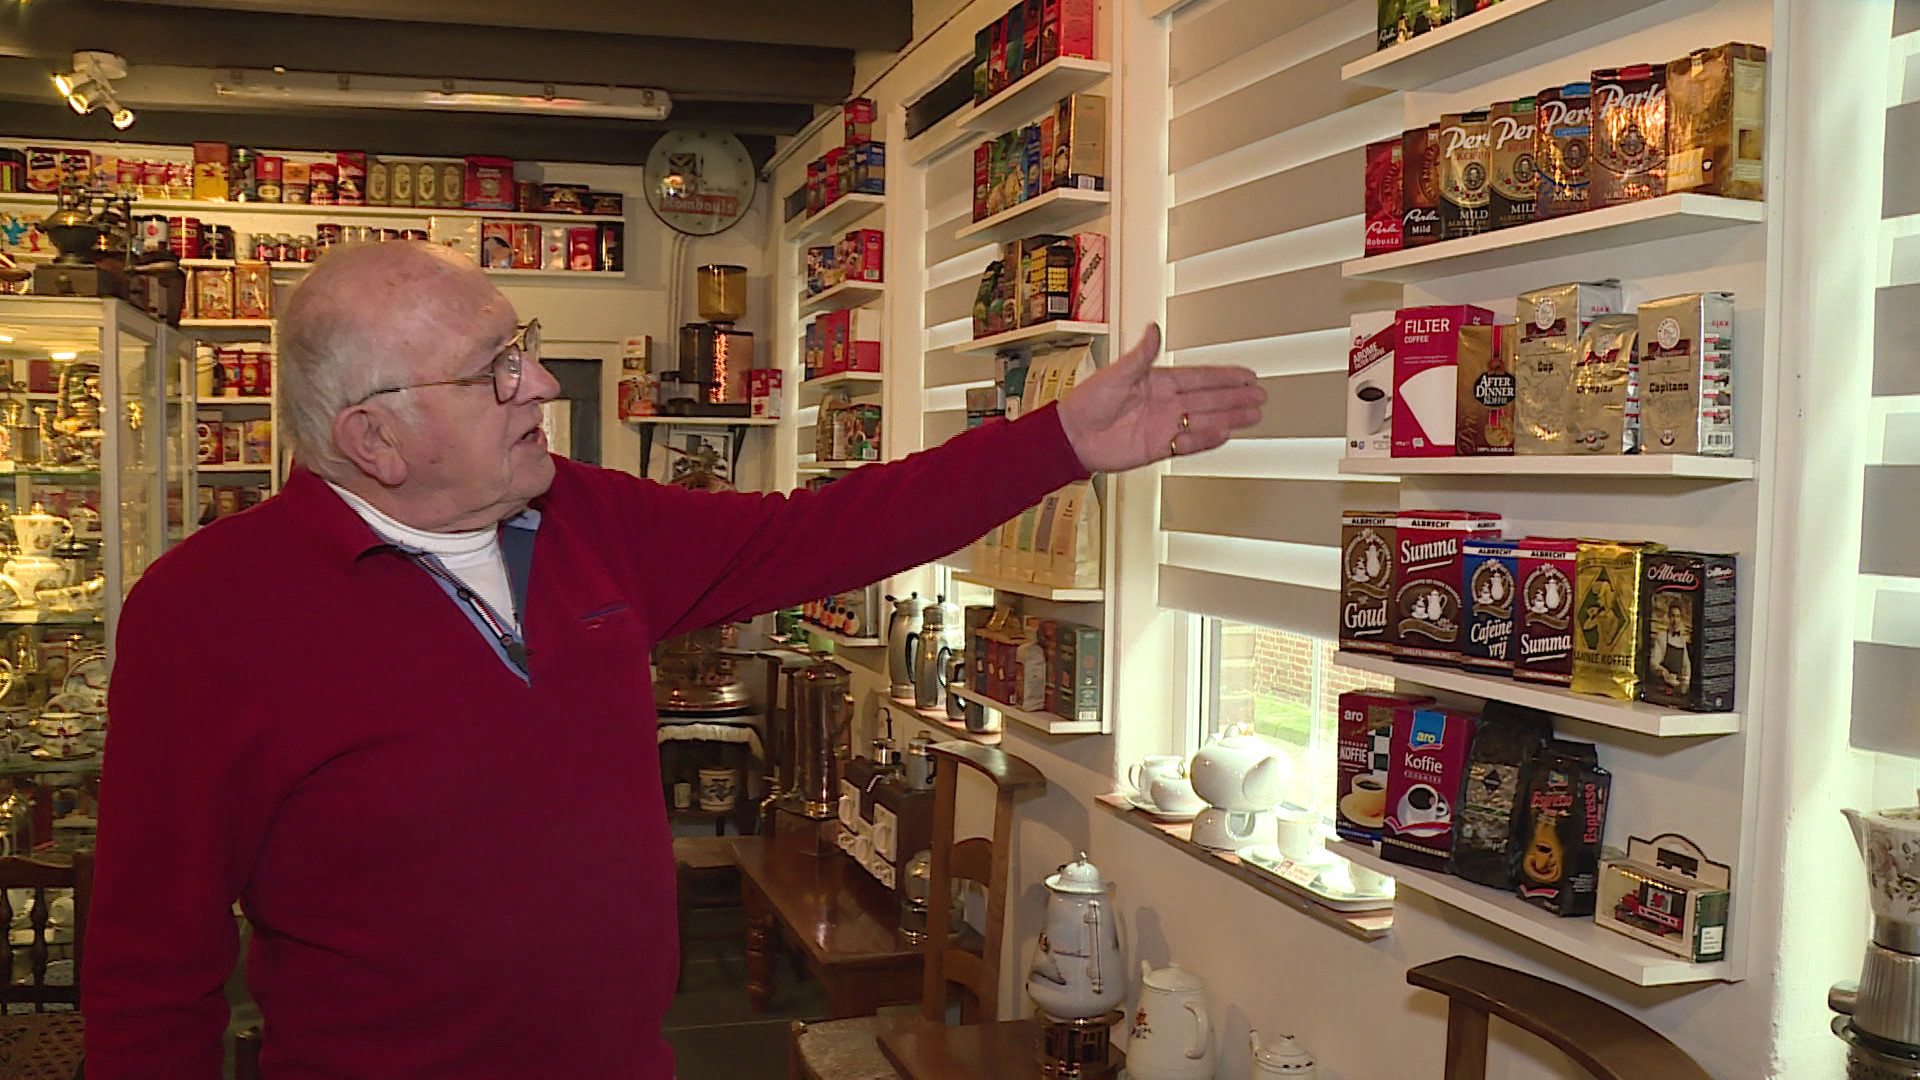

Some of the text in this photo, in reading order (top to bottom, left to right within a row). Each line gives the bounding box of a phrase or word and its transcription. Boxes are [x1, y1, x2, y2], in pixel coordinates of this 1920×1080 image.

[1540, 100, 1590, 134] Per
[1492, 117, 1536, 150] Per
[1442, 126, 1491, 158] Perl
[1553, 189, 1589, 201] MOKK
[1460, 209, 1489, 220] MILD
[1412, 225, 1432, 234] Mild
[1404, 319, 1450, 334] FILTER
[1404, 335, 1429, 344] COFFEE
[1480, 374, 1511, 387] AFTER
[1476, 385, 1514, 397] DINNER
[1411, 519, 1451, 528] ALBRECHT
[1401, 537, 1458, 564] Summa
[1530, 551, 1566, 559] ALBRECHT
[1647, 563, 1695, 583] Alberto
[1344, 600, 1387, 629] Goud
[1471, 618, 1513, 645] Cafeïne
[1488, 636, 1507, 659] vrij
[1521, 633, 1571, 655] Summa
[1601, 654, 1632, 667] KOFFIE
[1344, 710, 1364, 722] aro
[1416, 732, 1436, 743] aro
[1339, 746, 1367, 763] KOFFIE
[1404, 752, 1443, 774] Koffie
[1583, 783, 1600, 843] Espresso
